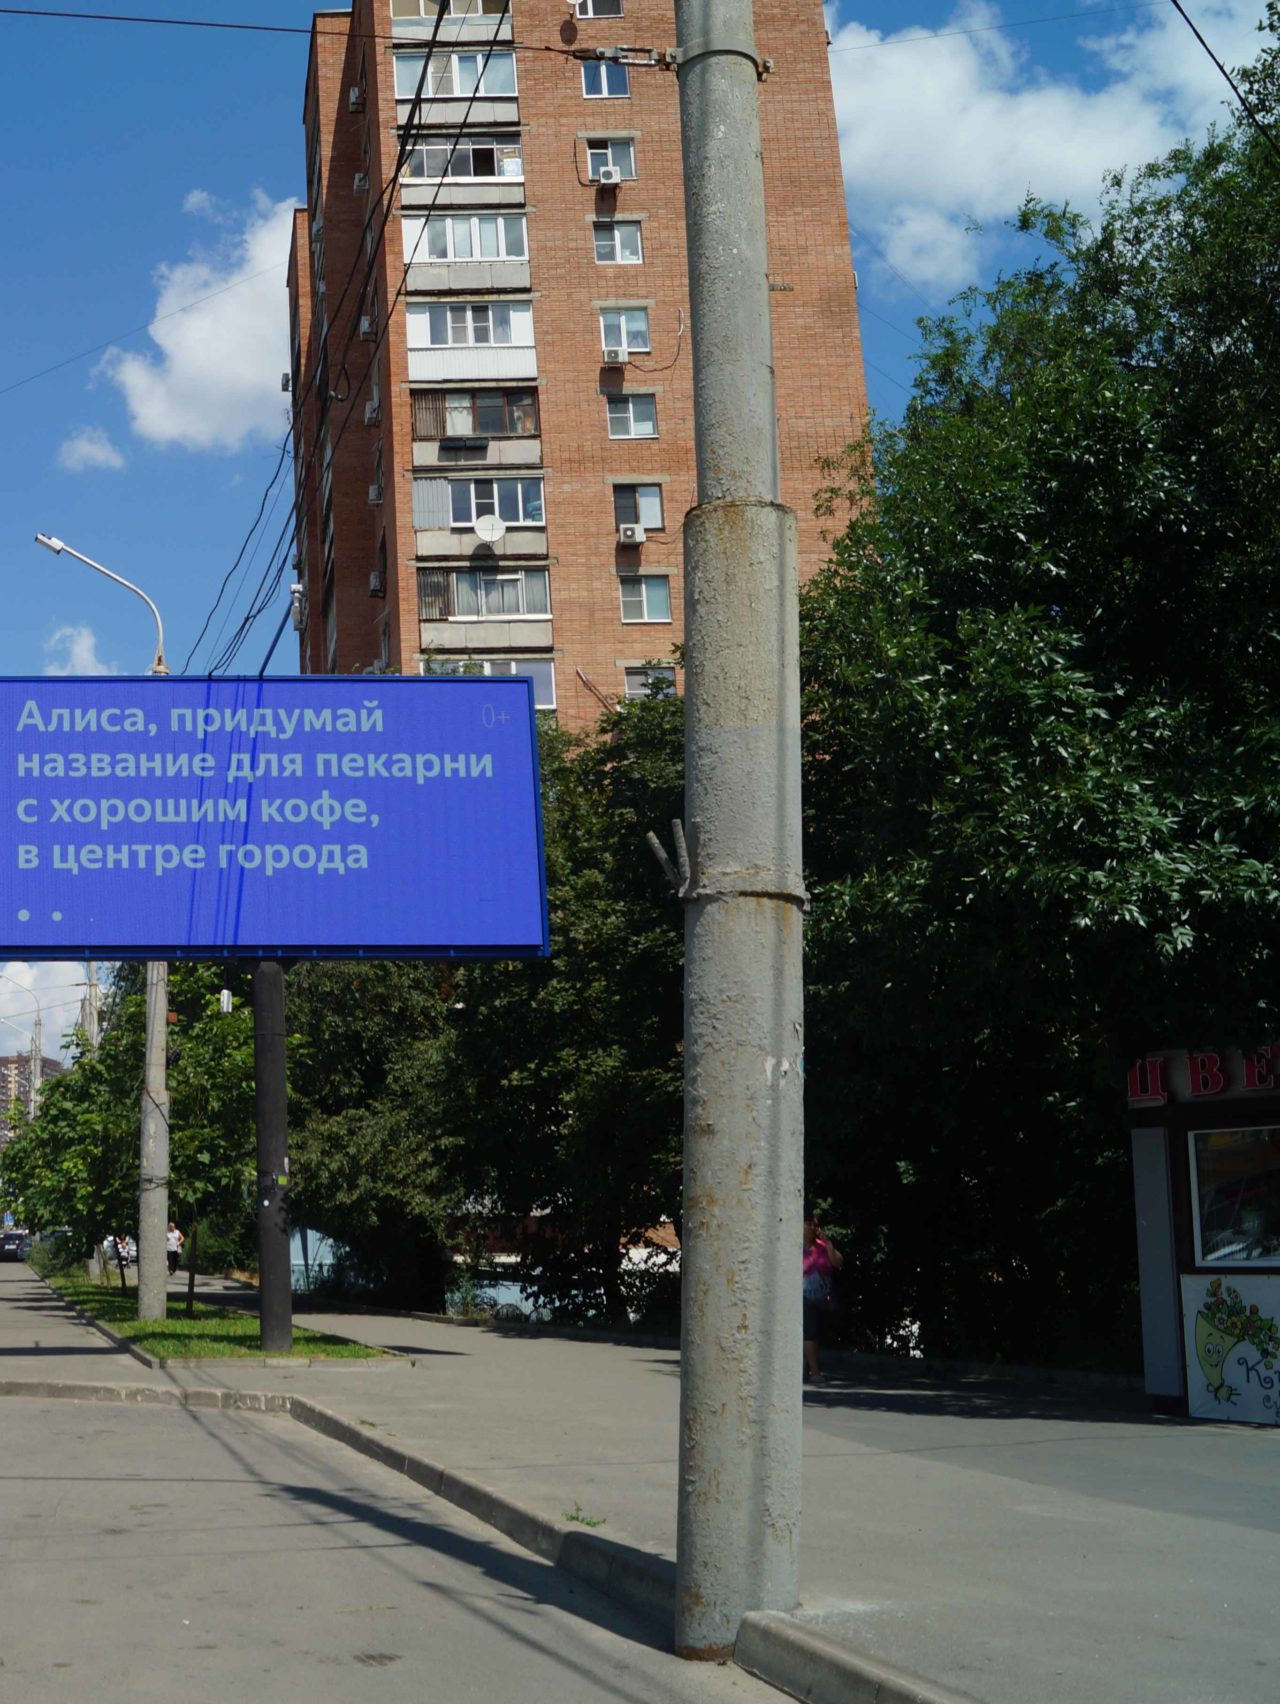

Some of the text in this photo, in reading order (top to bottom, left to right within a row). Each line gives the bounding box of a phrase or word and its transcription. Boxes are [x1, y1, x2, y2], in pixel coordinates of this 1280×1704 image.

[16, 699, 384, 740] Алиса, придумай
[481, 703, 510, 729] 0+
[17, 753, 494, 785] название для пекарни
[16, 789, 380, 831] с хорошим кофе,
[17, 844, 369, 876] в центре города
